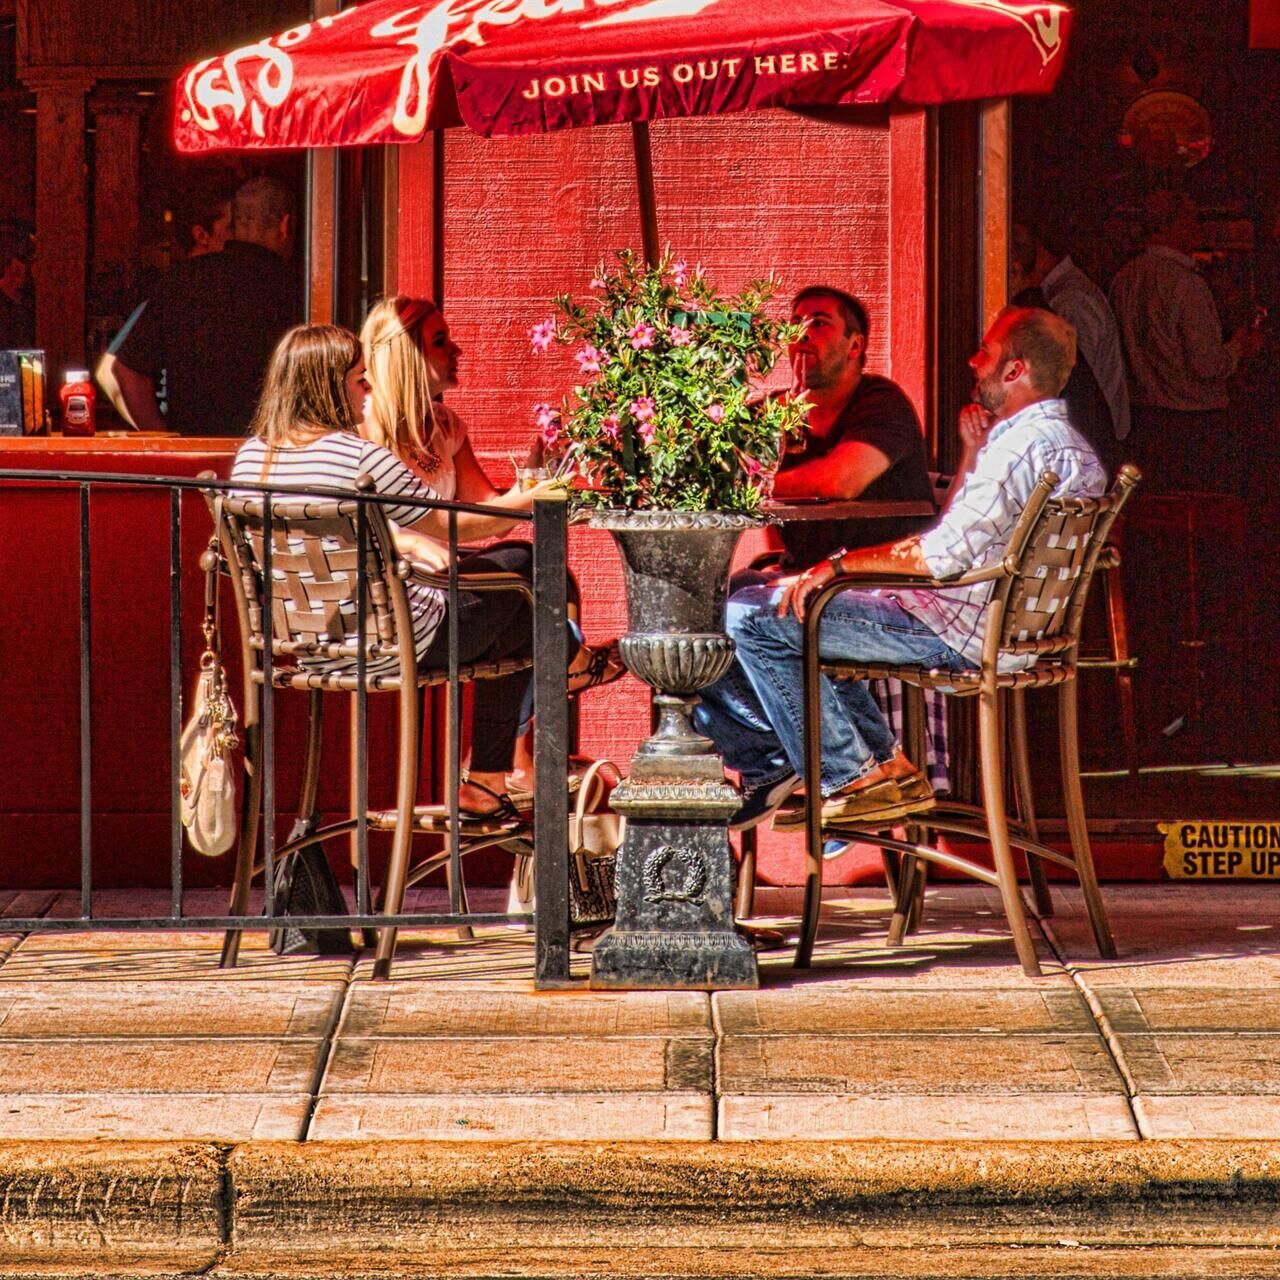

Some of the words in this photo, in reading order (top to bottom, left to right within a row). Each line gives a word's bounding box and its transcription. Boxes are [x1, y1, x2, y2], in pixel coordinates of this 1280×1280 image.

[522, 71, 606, 100] JOIN
[619, 67, 661, 89] US
[672, 58, 740, 83] OUT
[1183, 851, 1243, 876] STEP
